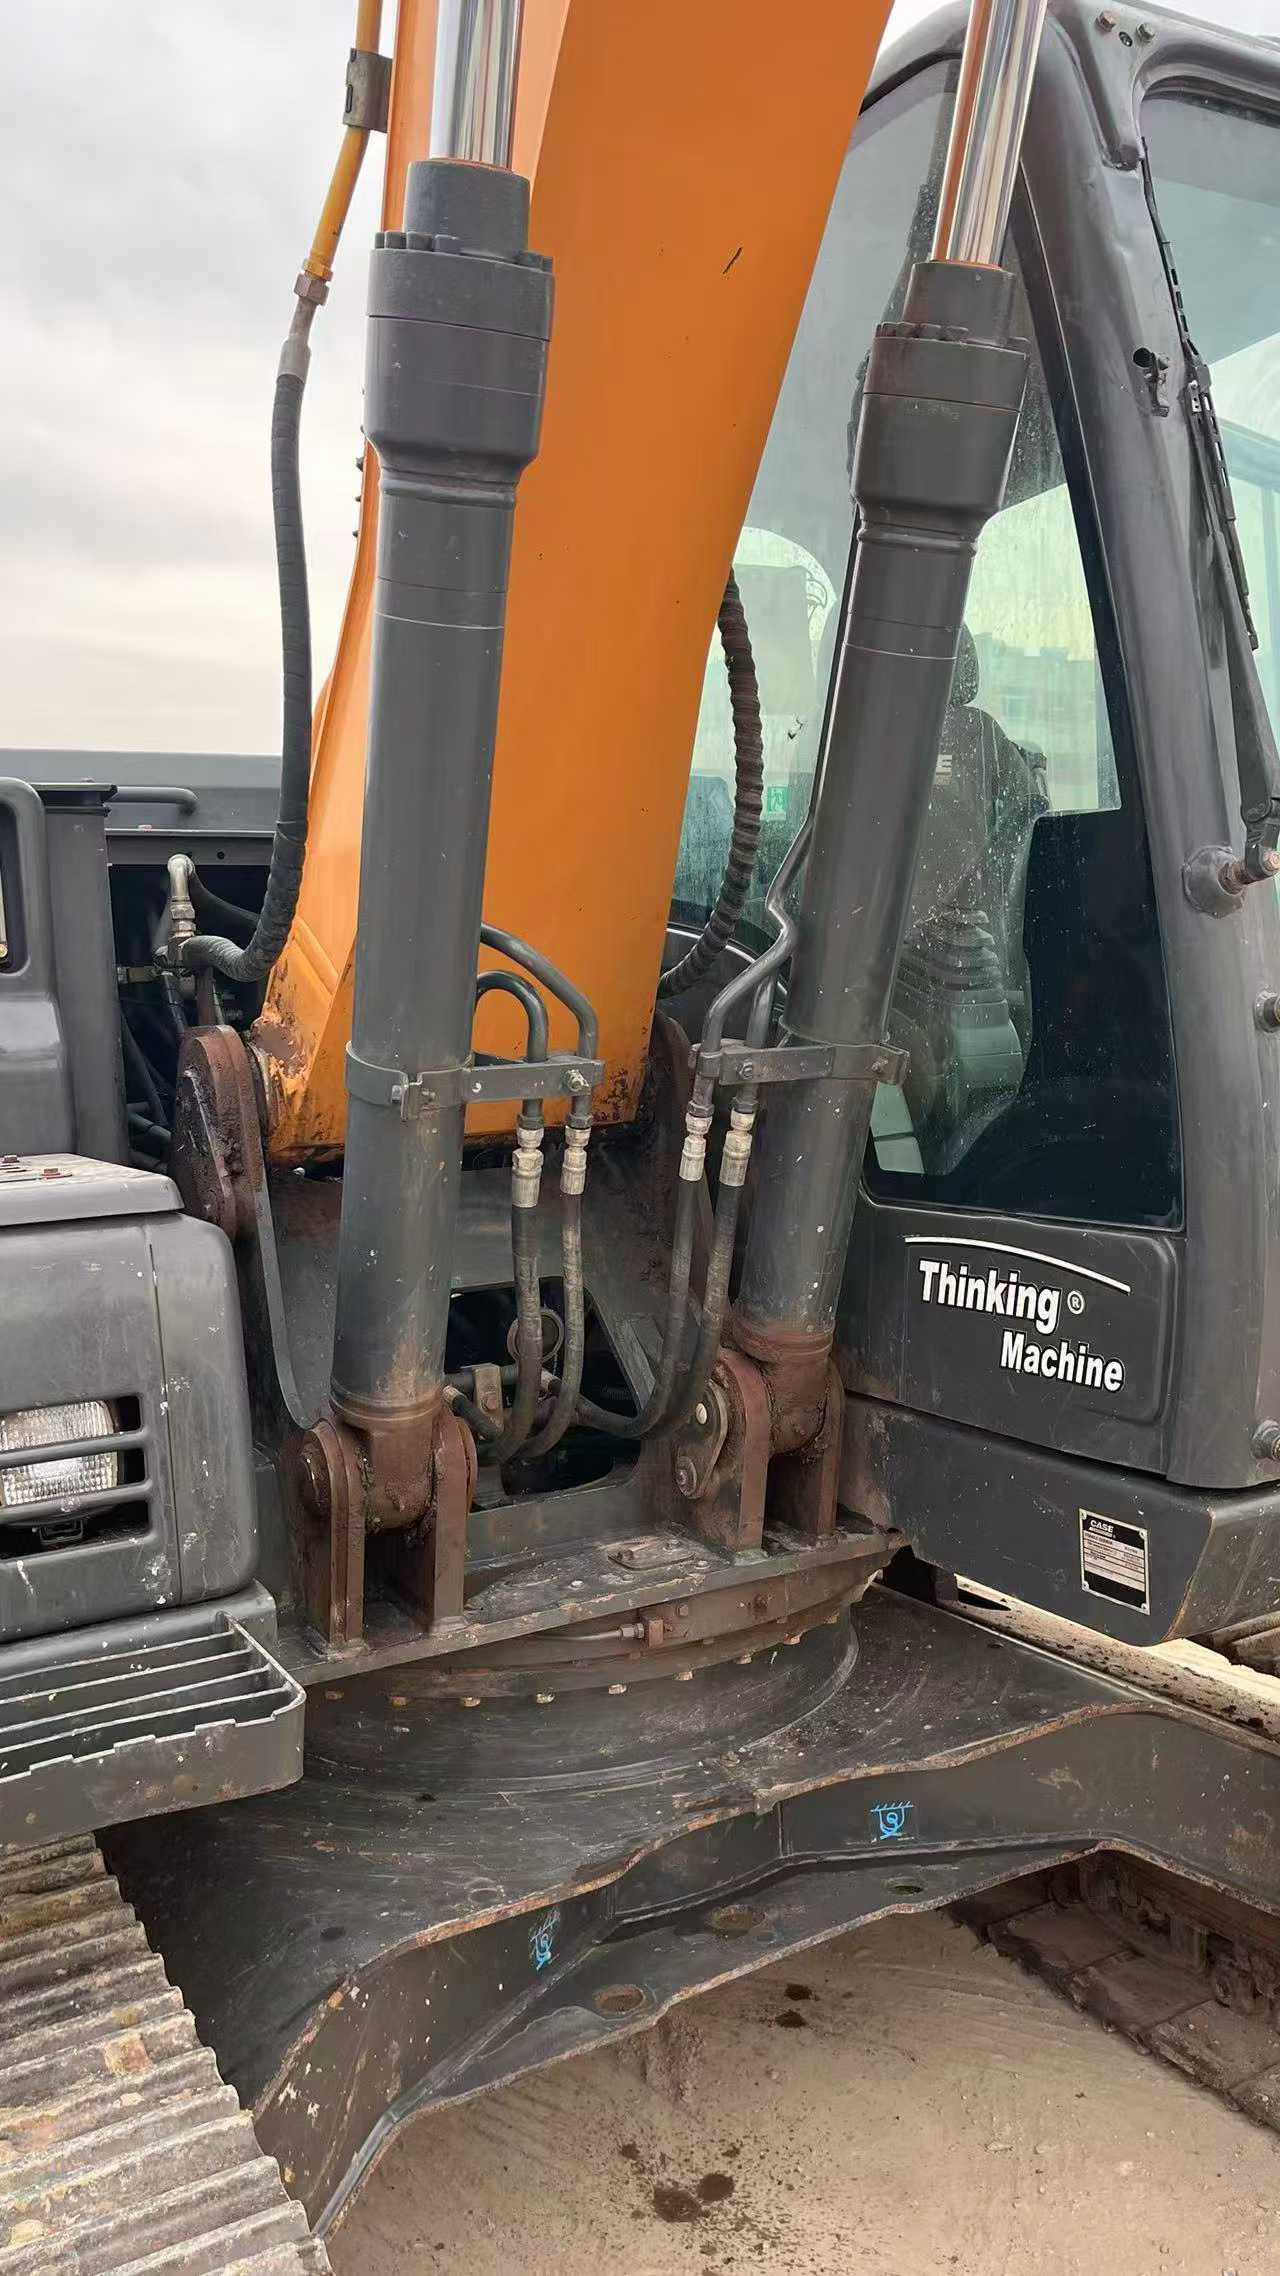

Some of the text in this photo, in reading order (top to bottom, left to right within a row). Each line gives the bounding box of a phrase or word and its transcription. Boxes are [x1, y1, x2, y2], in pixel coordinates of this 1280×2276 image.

[919, 1259, 1061, 1334] Thinking
[1000, 1330, 1125, 1392] Machine
[1090, 1519, 1114, 1533] CASE
